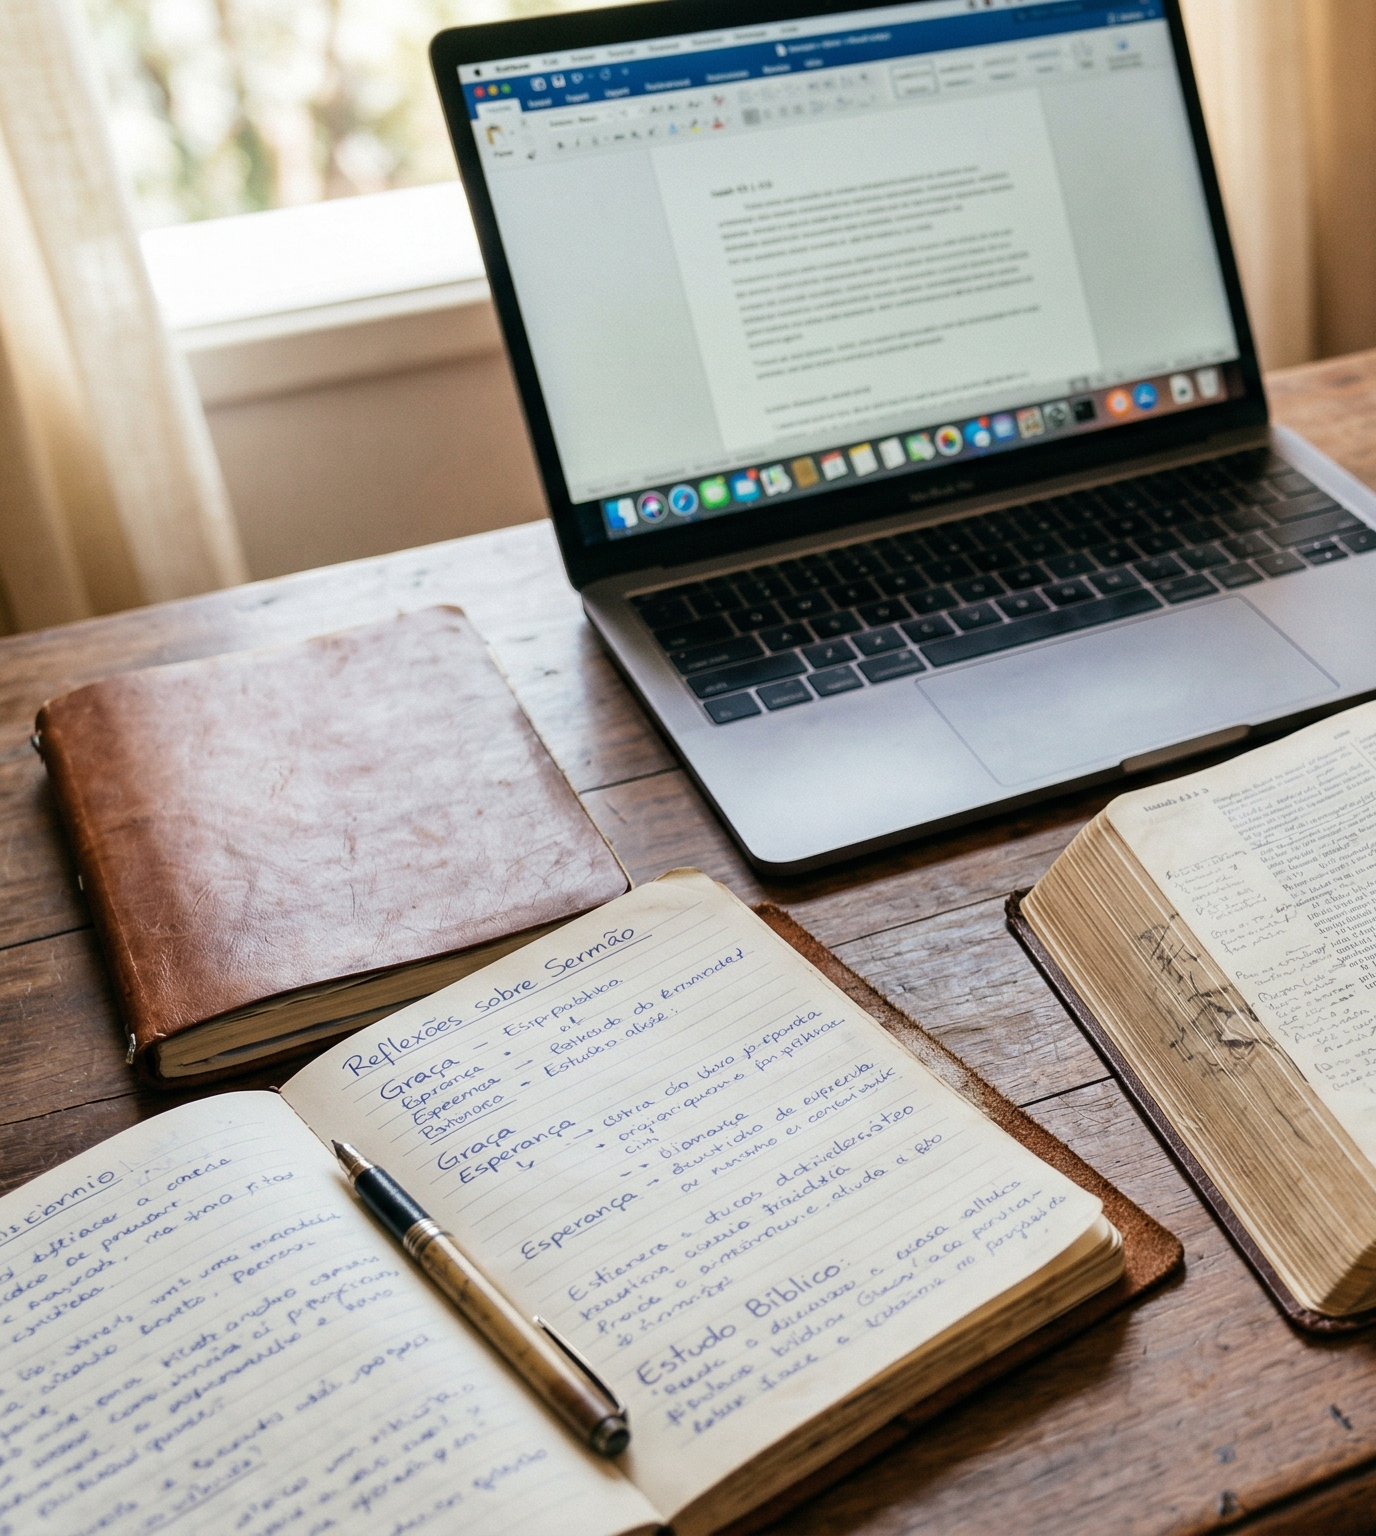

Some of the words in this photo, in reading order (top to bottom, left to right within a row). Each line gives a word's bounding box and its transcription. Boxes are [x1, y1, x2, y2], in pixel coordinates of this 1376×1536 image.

[342, 1015, 463, 1077] Reflexões
[474, 979, 539, 1013] sobre
[544, 927, 636, 978] Sermão
[379, 1058, 460, 1101] Graça
[437, 1125, 517, 1171] Graça
[457, 1117, 577, 1186] Esperança
[521, 1191, 639, 1261] Esperança
[636, 1322, 738, 1388] Estudo
